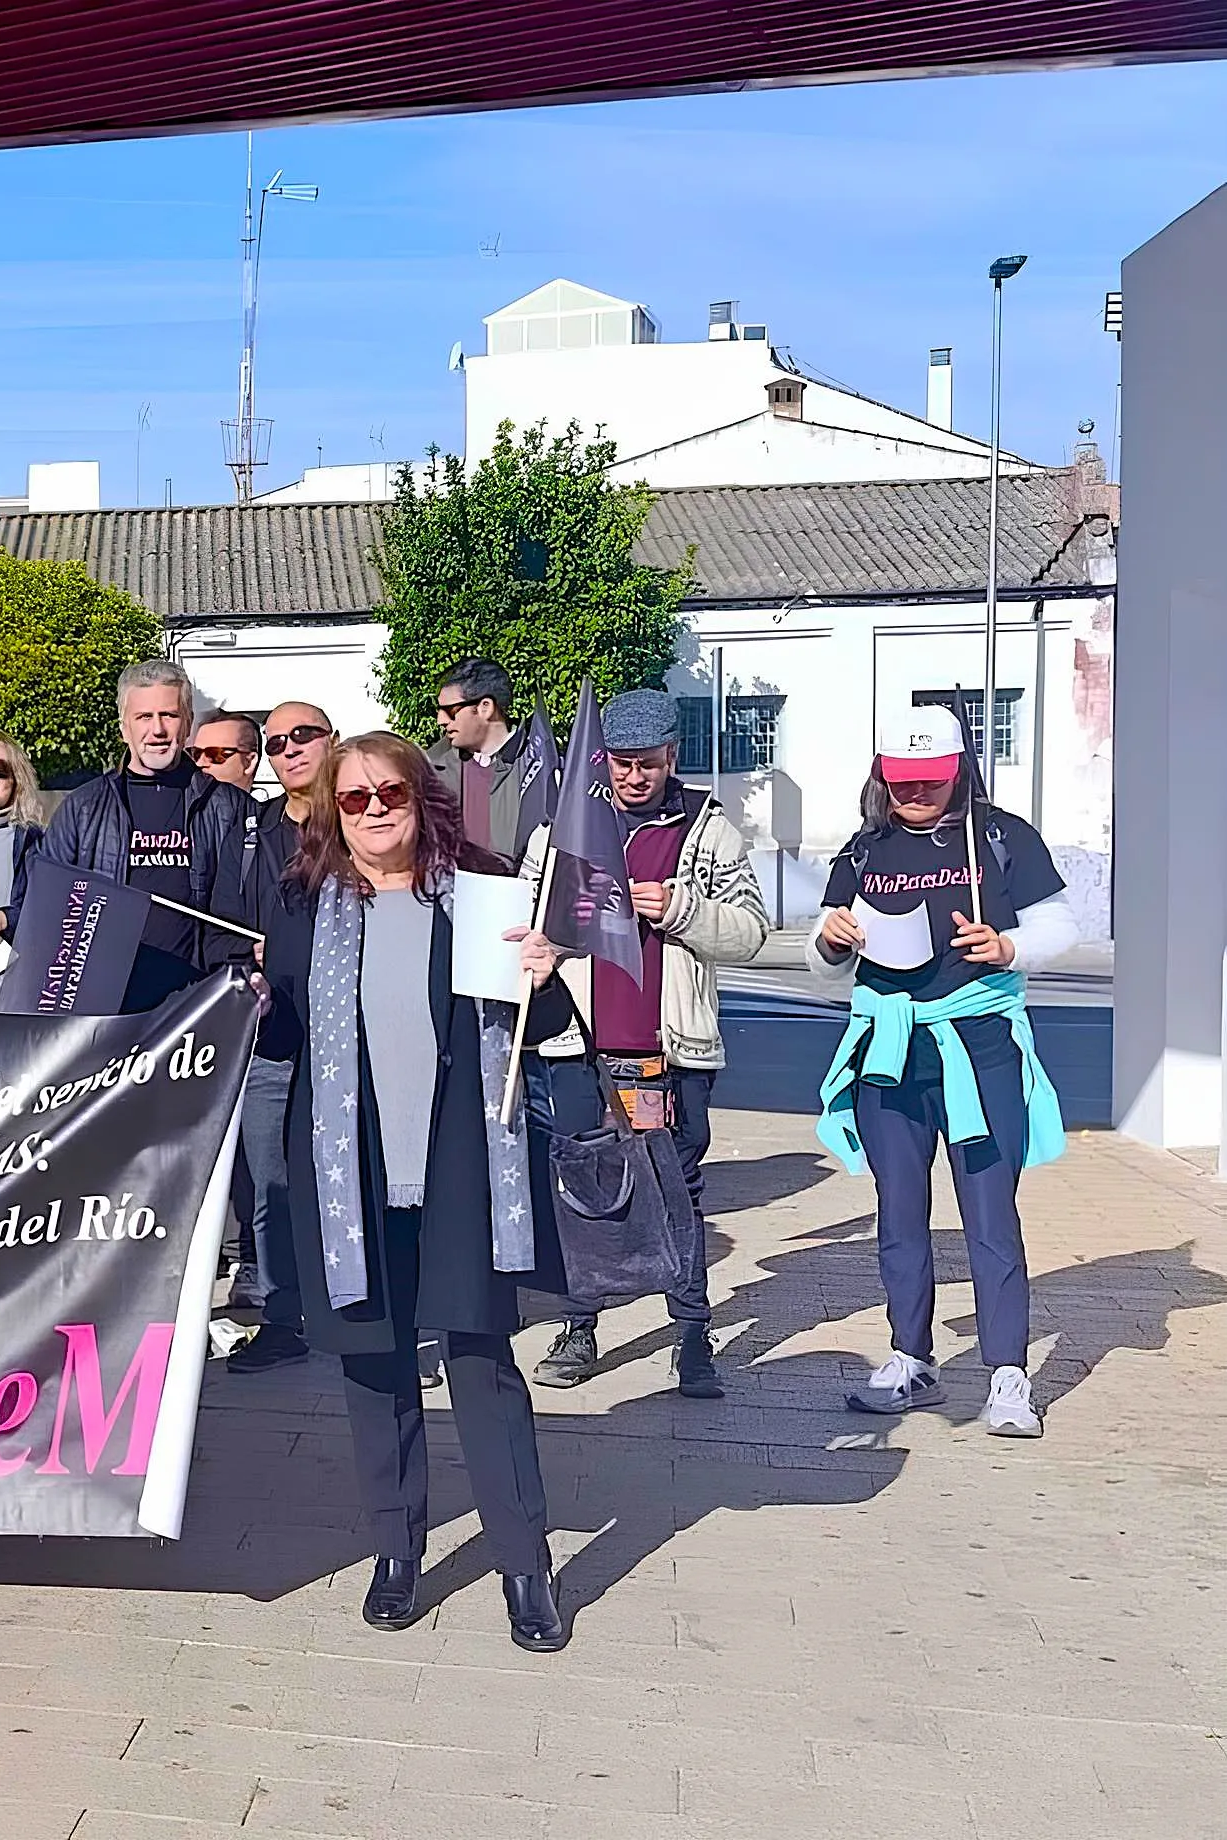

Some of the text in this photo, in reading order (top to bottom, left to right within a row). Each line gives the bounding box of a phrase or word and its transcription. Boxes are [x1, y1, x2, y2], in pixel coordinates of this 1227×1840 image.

[32, 1043, 157, 1115] servicio
[168, 1032, 216, 1081] de
[72, 1193, 168, 1242] Río.
